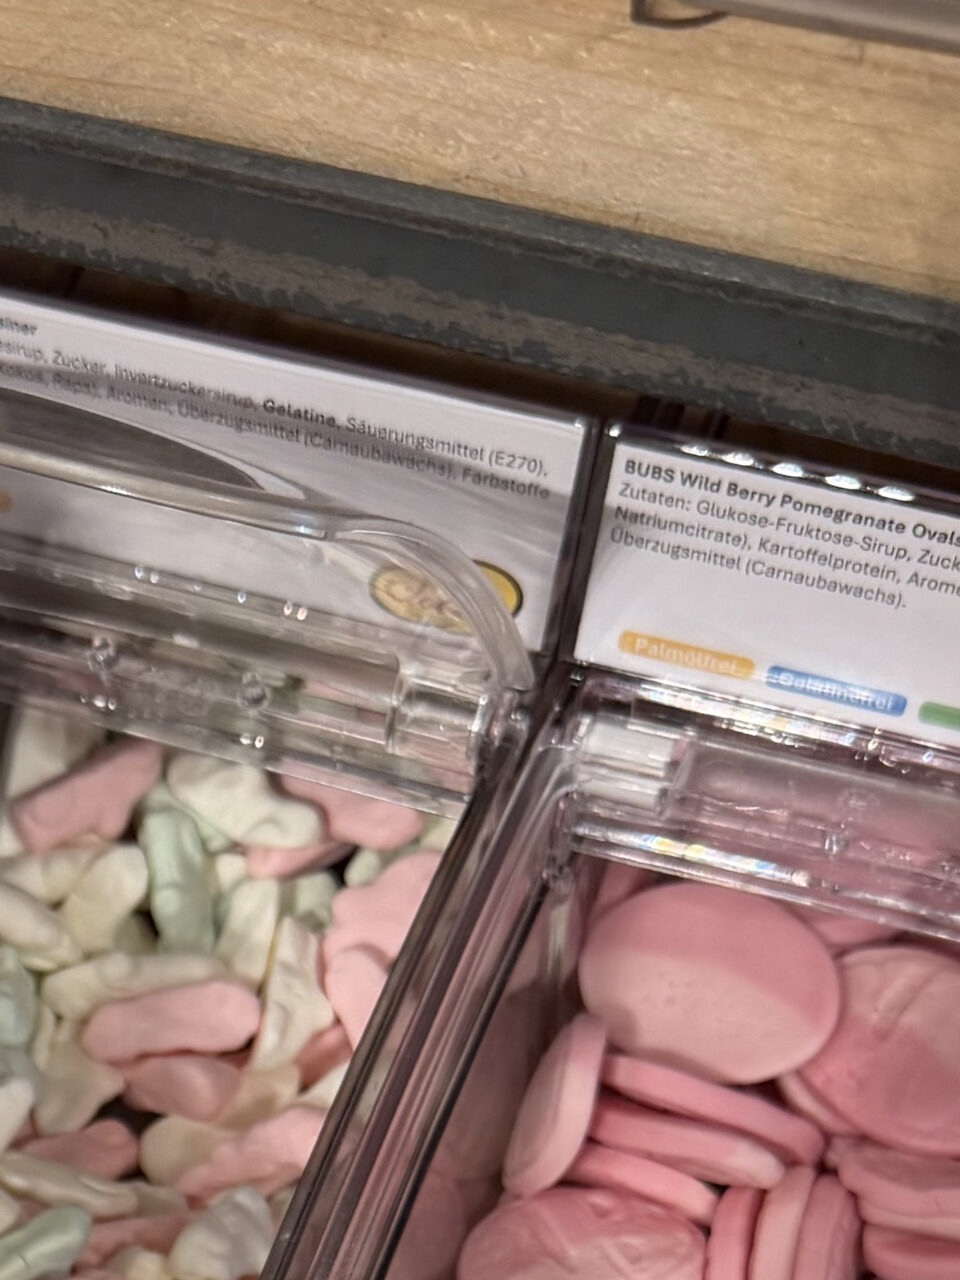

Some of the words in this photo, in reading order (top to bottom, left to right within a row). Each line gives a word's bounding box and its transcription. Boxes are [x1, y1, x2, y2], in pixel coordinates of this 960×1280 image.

[346, 416, 485, 463] Säuerungsmittel
[462, 467, 551, 500] Farbstoffe
[623, 459, 676, 484] BUBS
[680, 472, 722, 495] Wild
[726, 482, 777, 509] Berry
[780, 493, 907, 535] Pomegranate
[614, 506, 752, 552] Natriumcitrate),
[758, 537, 901, 585] Kartoffelprotein,
[619, 482, 691, 512] Zutaten:
[696, 499, 912, 563] Glukose-Fruktose-Sirup,
[610, 525, 742, 571] Überzugsmittel
[745, 553, 907, 610] (Carnaubawachs).
